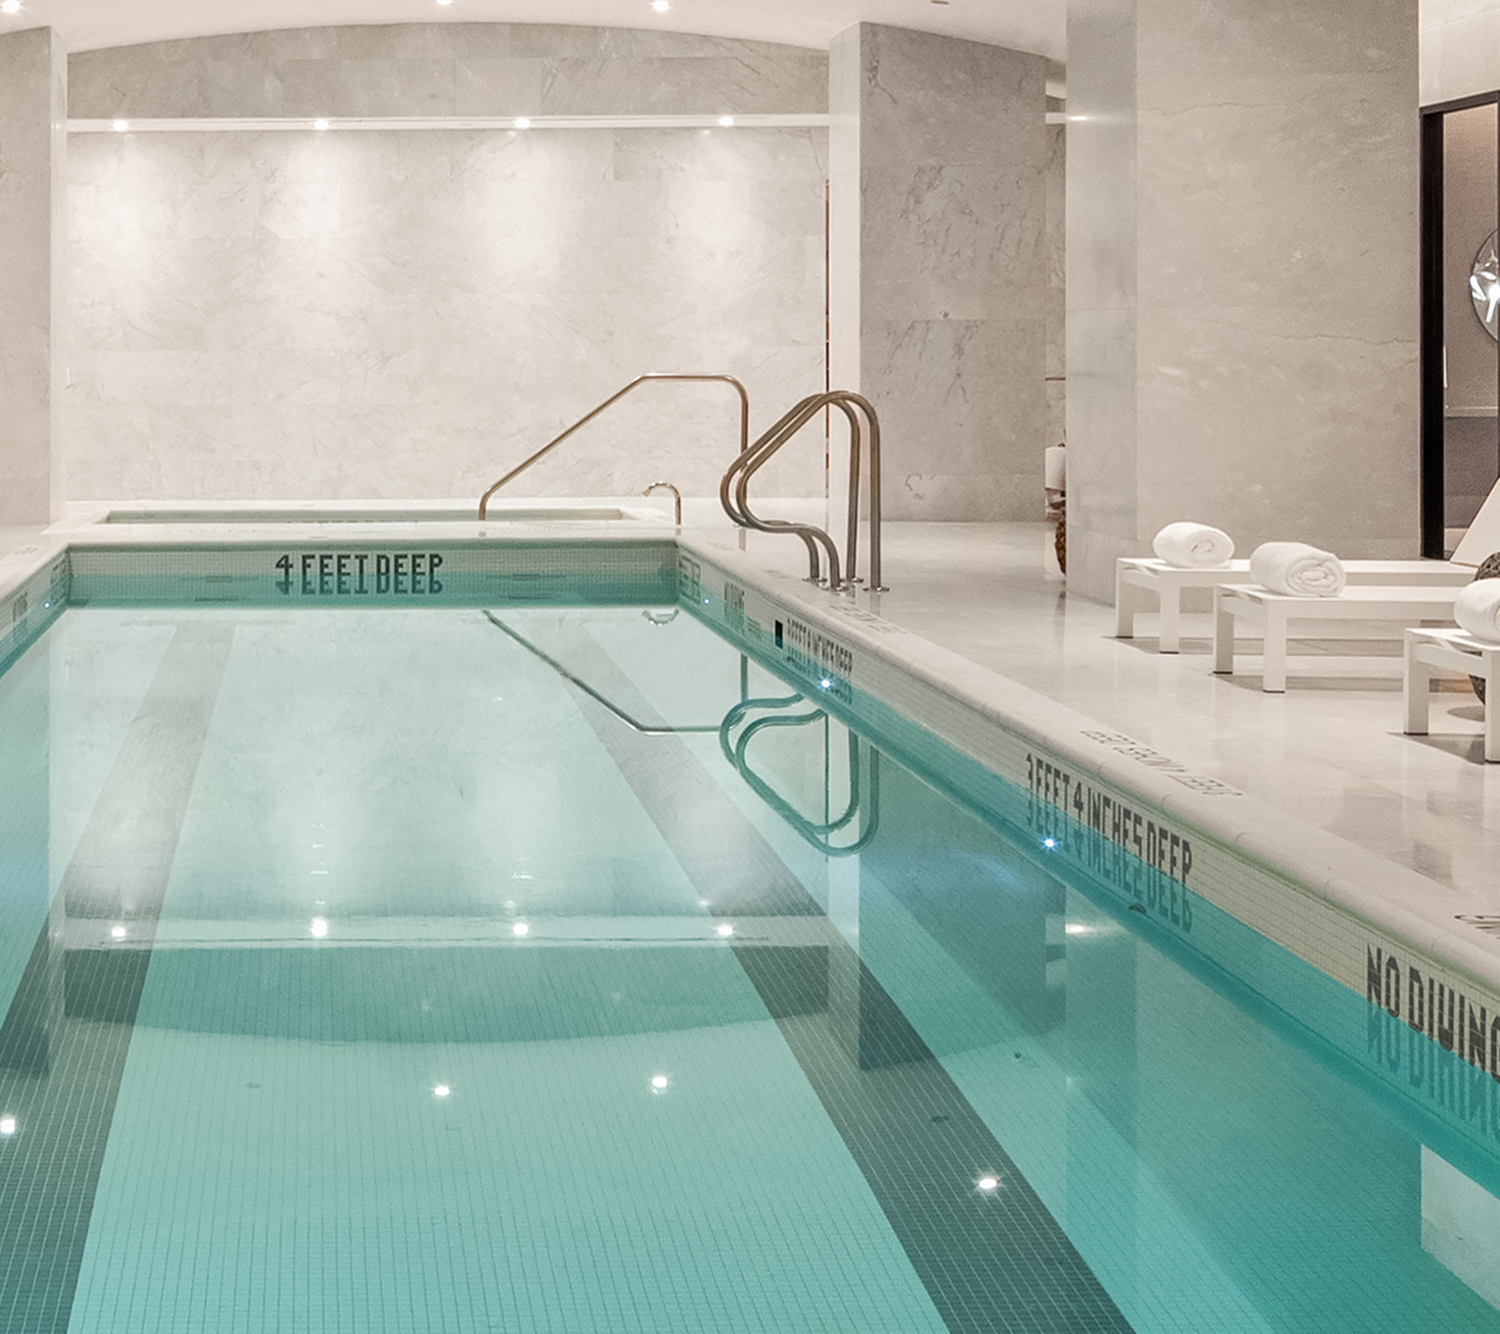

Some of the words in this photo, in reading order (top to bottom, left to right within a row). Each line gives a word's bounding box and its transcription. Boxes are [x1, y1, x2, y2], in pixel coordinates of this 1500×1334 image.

[275, 554, 293, 576] 4
[301, 554, 369, 576] FEET
[376, 554, 443, 576] DEEP
[1074, 781, 1083, 819] 4
[1147, 819, 1192, 887] DEEP
[1367, 942, 1400, 1018] NO
